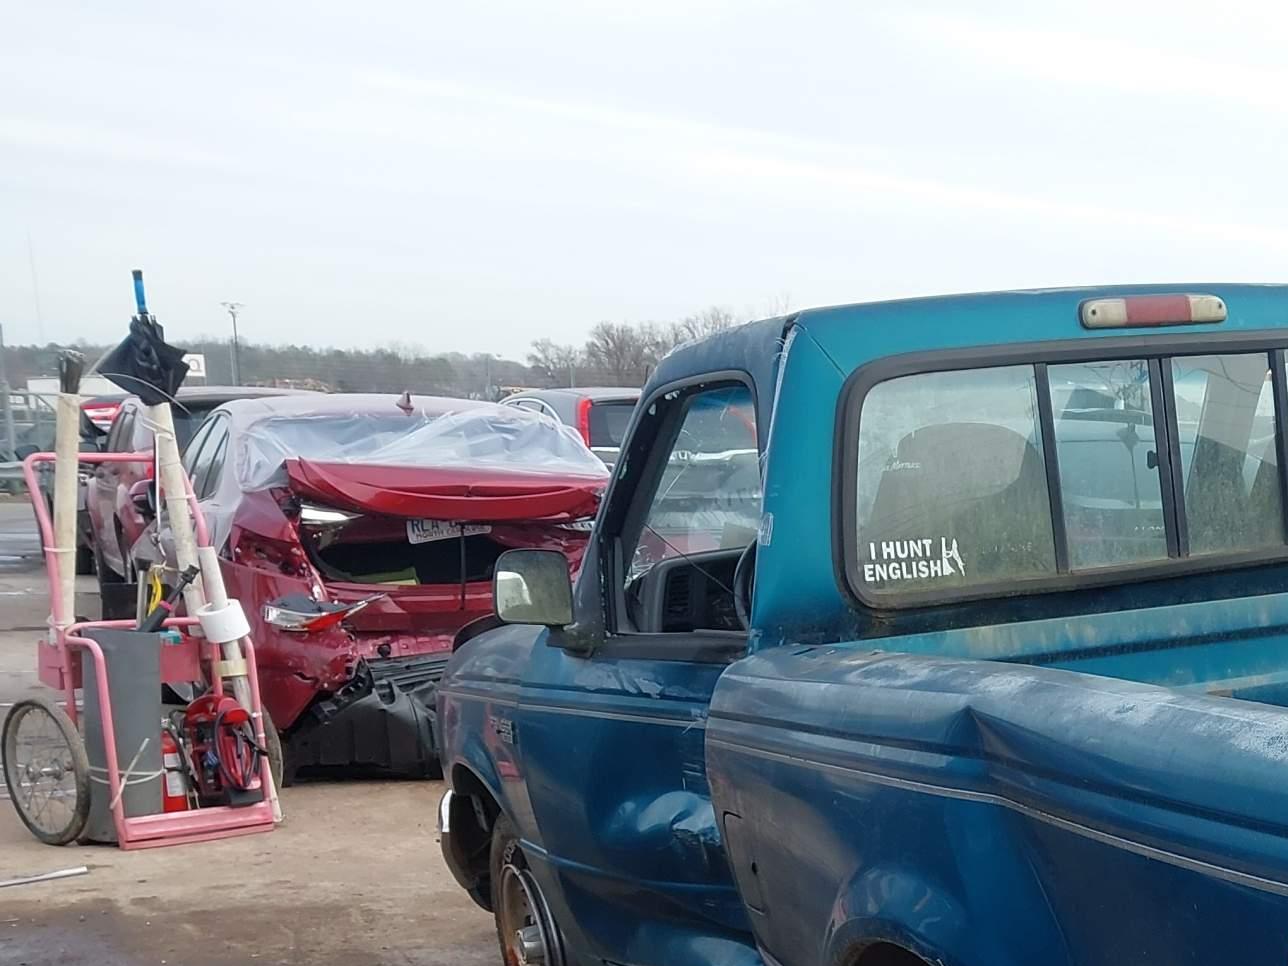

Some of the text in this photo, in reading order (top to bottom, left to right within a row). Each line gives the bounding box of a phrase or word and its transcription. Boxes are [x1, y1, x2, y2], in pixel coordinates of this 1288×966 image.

[869, 539, 932, 560] I HUNT
[864, 560, 942, 582] ENGLISH
